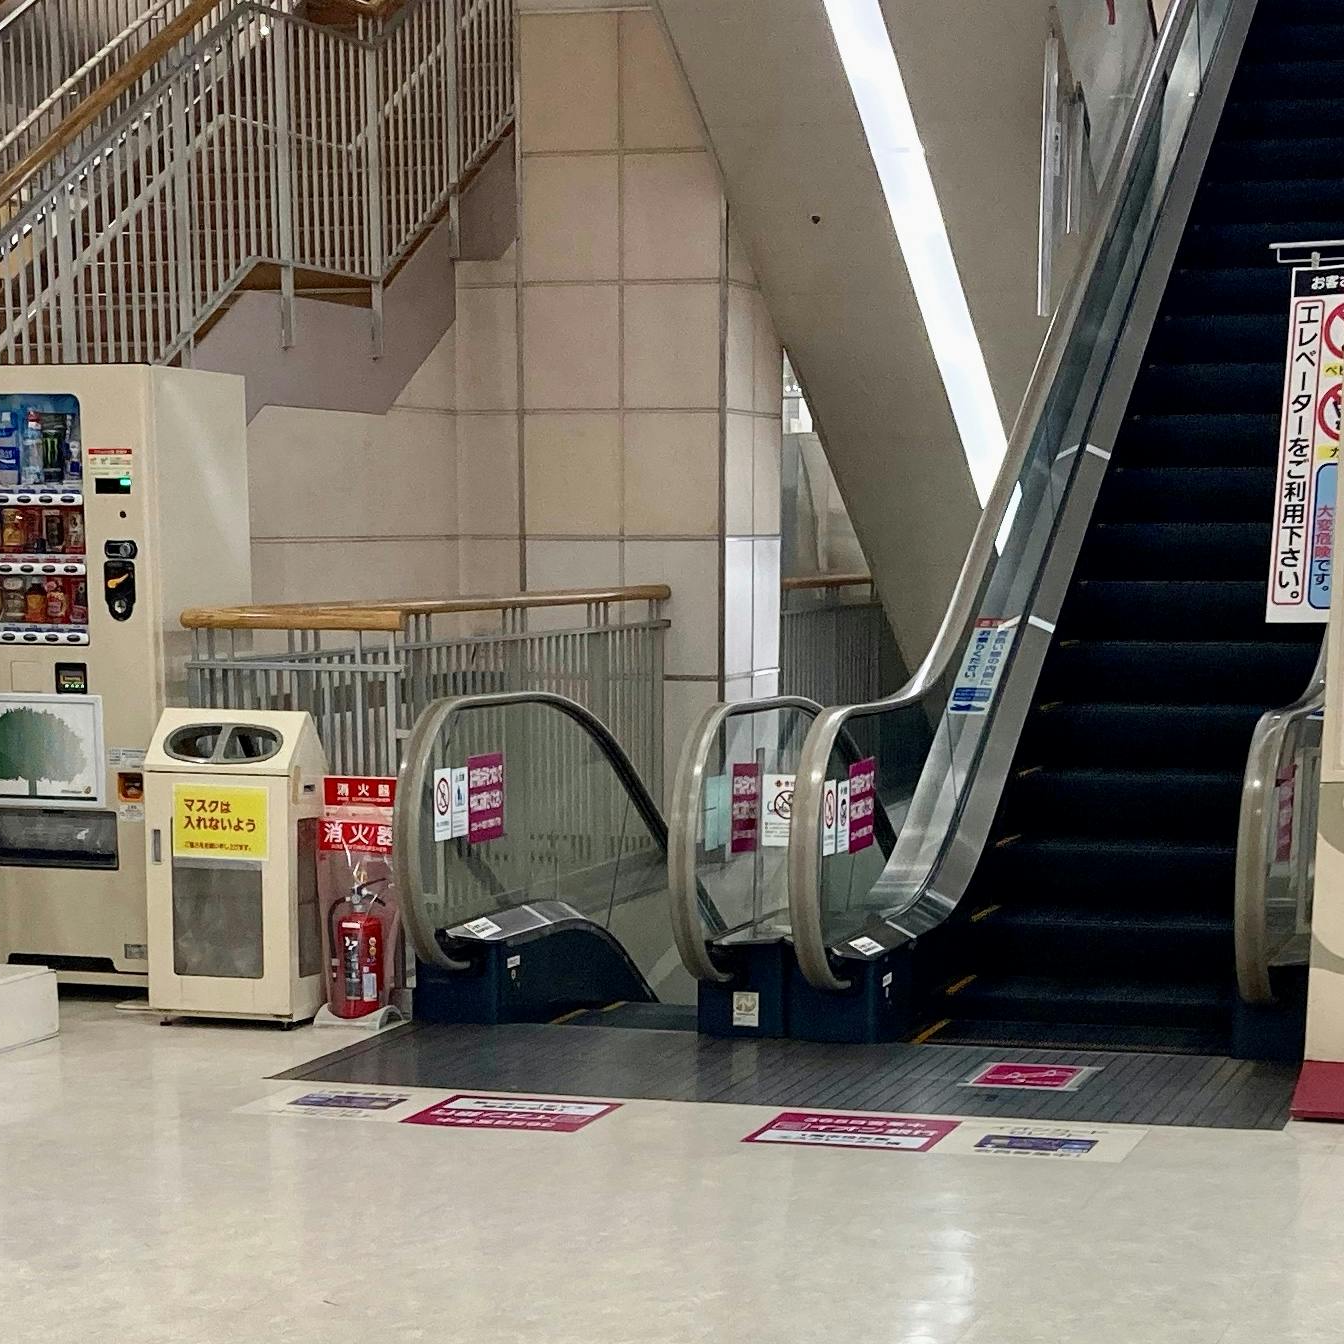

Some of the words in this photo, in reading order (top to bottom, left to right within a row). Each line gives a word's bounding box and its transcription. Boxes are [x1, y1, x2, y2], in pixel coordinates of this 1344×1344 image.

[1278, 305, 1319, 600] エレベーターをご利用下さい。
[1313, 505, 1334, 592] 大変危険です。
[337, 783, 390, 797] 消火器
[184, 799, 231, 814] マスクは
[183, 816, 256, 832] 入れないよう
[324, 822, 393, 846] 消火器
